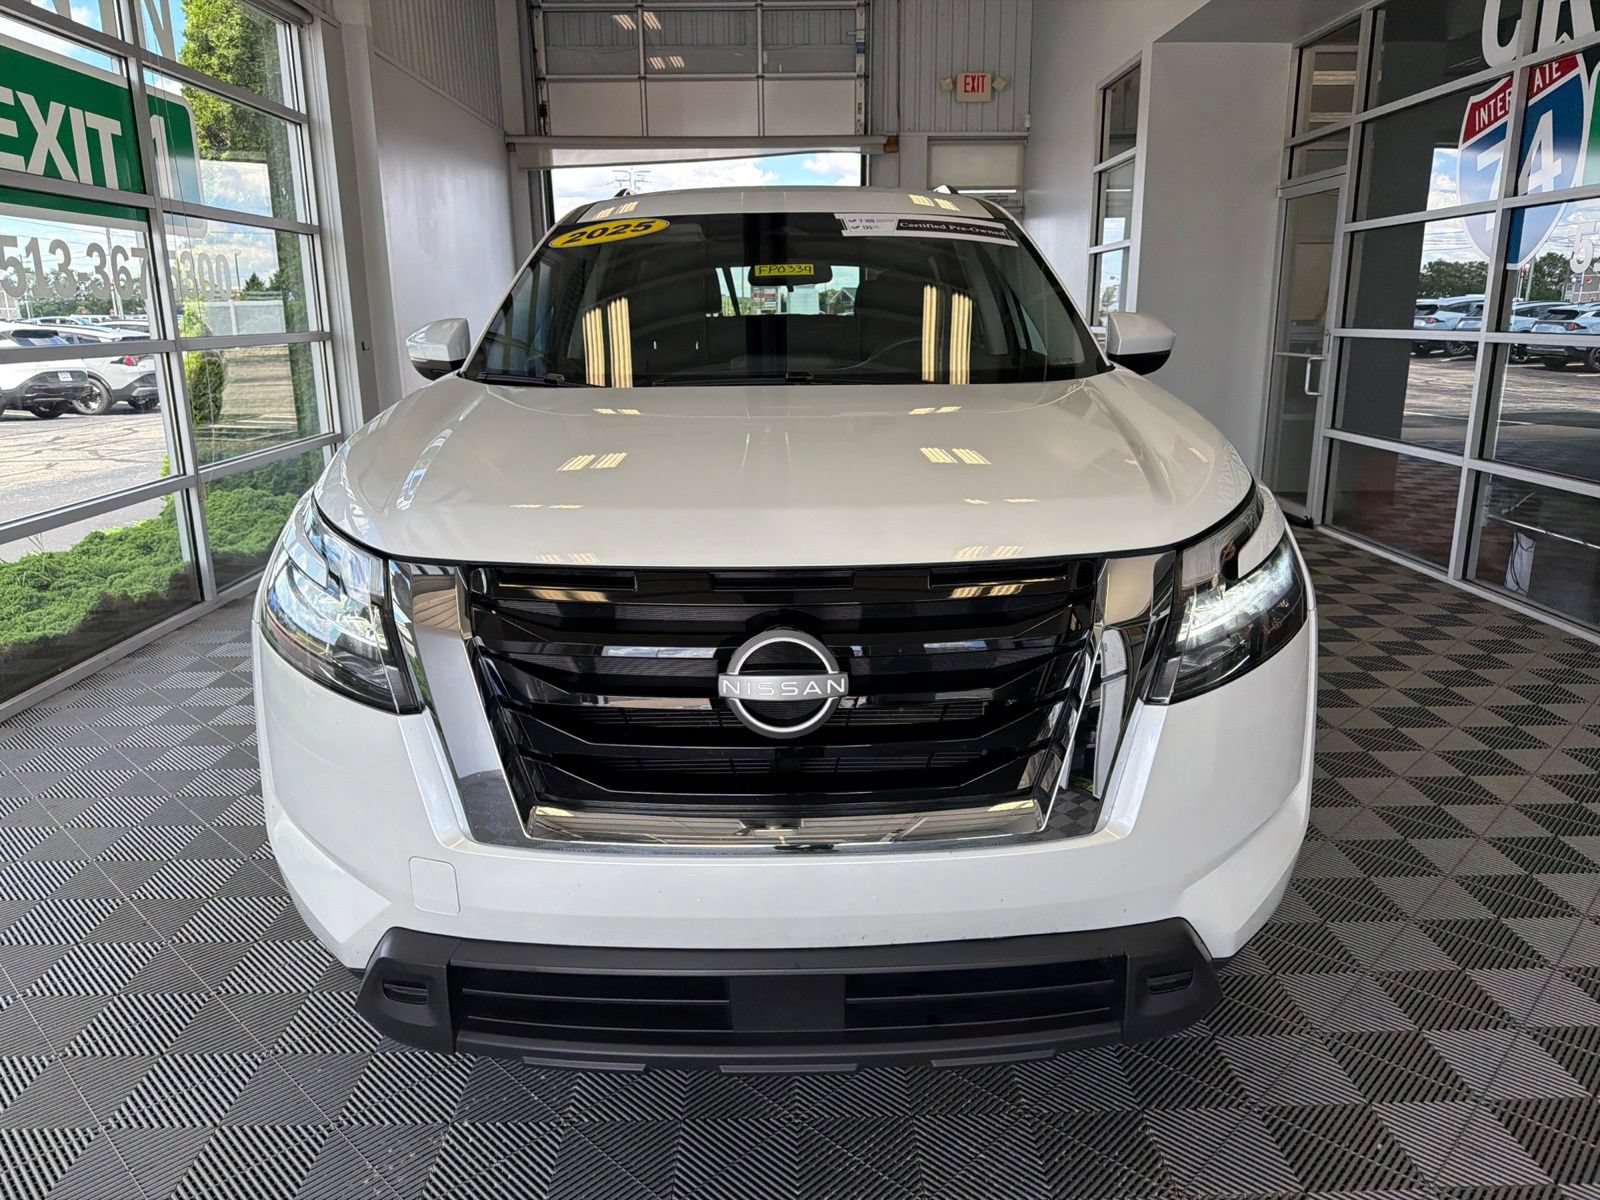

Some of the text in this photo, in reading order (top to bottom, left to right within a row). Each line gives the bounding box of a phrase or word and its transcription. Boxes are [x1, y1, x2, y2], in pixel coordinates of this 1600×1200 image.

[963, 74, 986, 93] EXIT
[560, 220, 657, 246] 2025
[899, 221, 947, 231] Certified
[948, 224, 1006, 237] Pre-Owned
[722, 677, 845, 696] NISSAN
